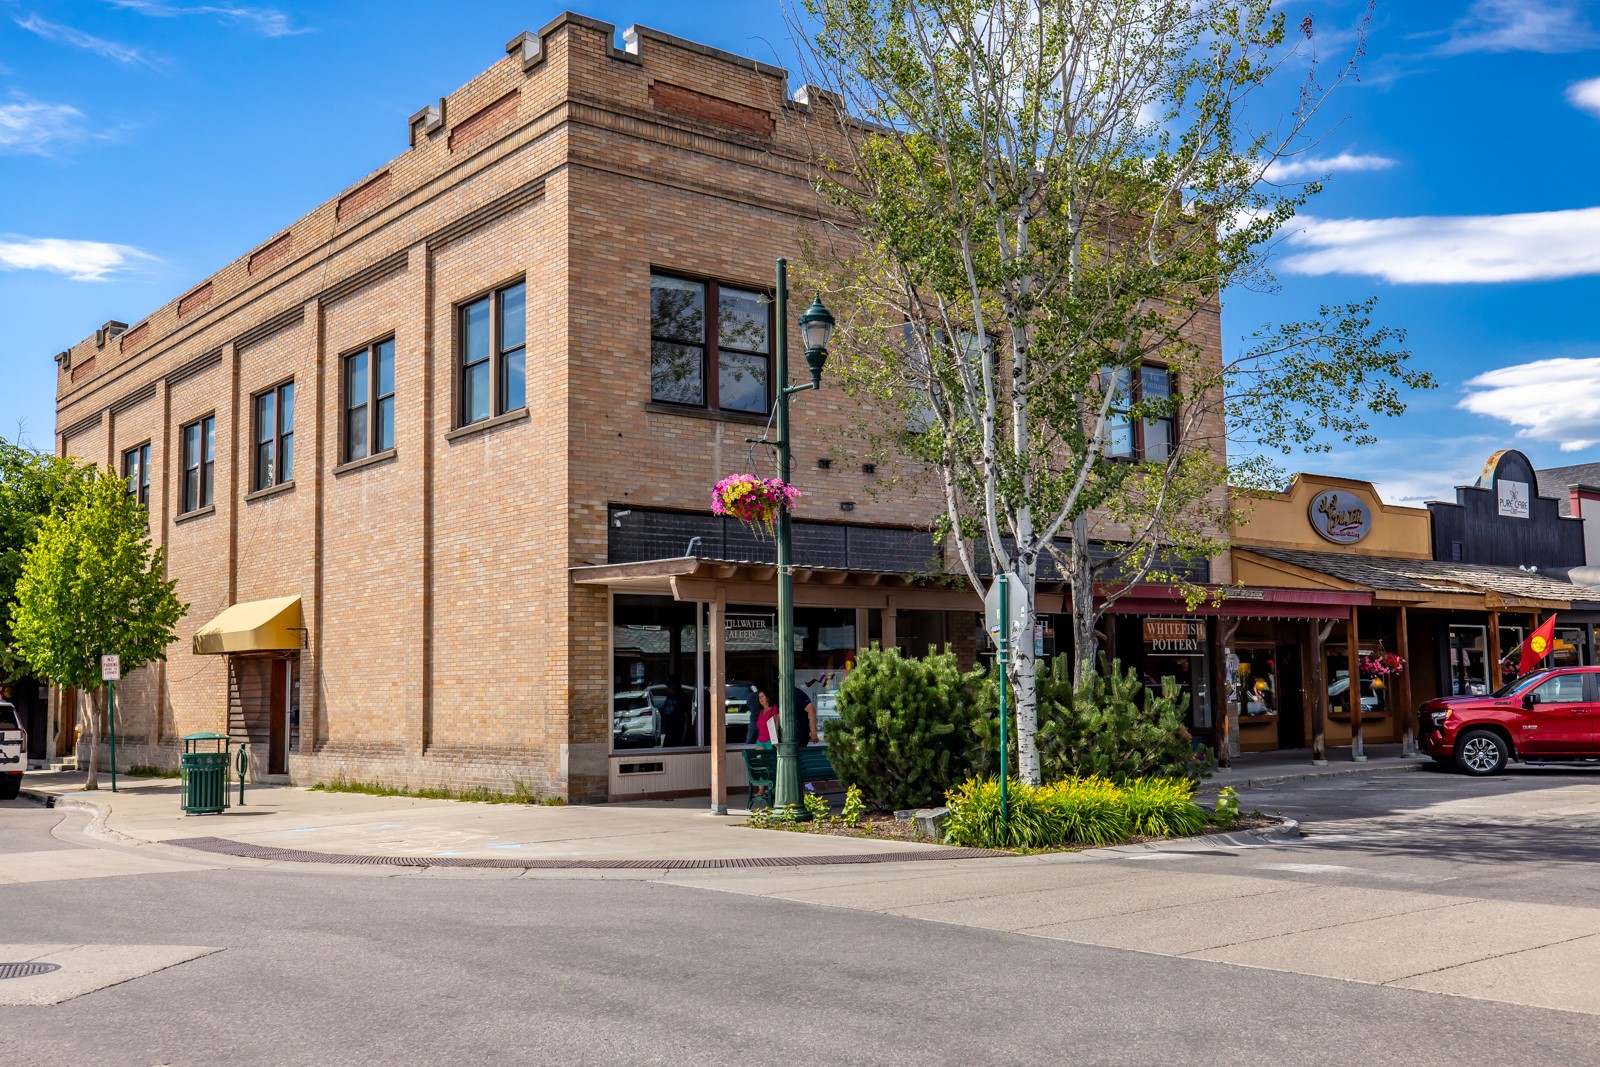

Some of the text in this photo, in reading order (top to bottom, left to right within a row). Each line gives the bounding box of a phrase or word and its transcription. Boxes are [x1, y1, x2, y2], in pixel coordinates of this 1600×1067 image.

[1499, 498, 1528, 510] PURE CARE
[724, 619, 767, 628] TILLWATER
[1146, 623, 1203, 635] WHITEFISH
[726, 630, 758, 639] ALLERY
[1152, 638, 1199, 651] POTTERY
